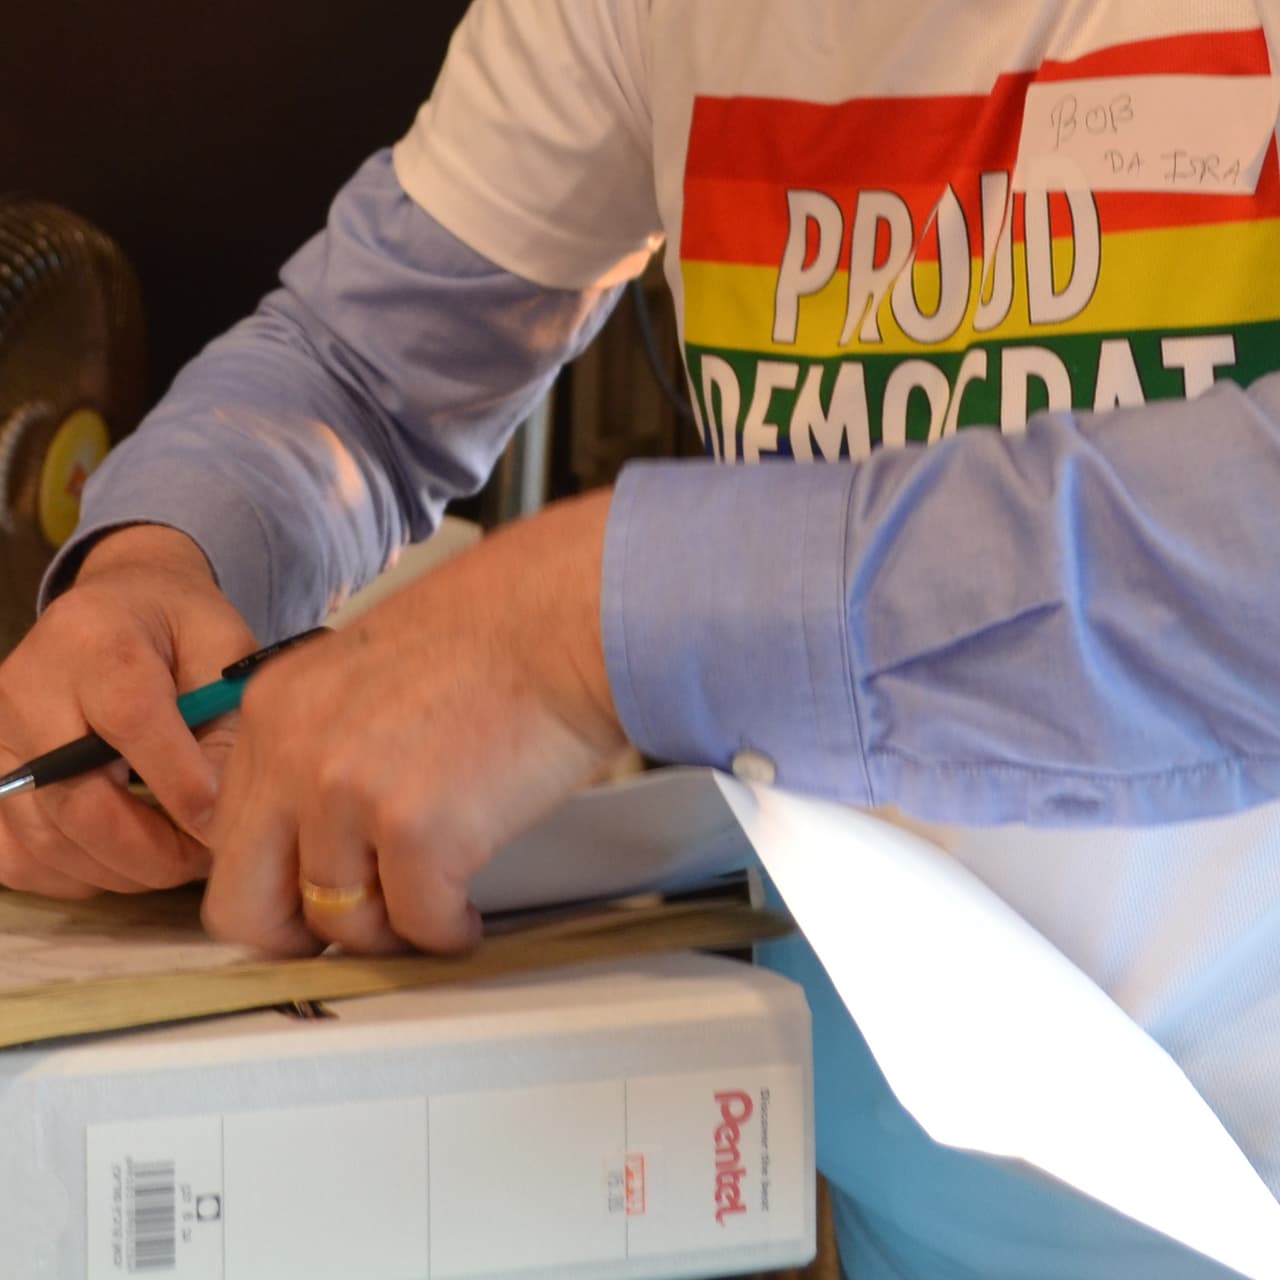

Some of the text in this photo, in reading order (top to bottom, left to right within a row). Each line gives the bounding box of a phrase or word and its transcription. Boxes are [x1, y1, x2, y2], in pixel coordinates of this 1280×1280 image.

[1050, 94, 1135, 150] BOB
[771, 158, 1101, 346] PROUD
[713, 1089, 753, 1227] Pentel
